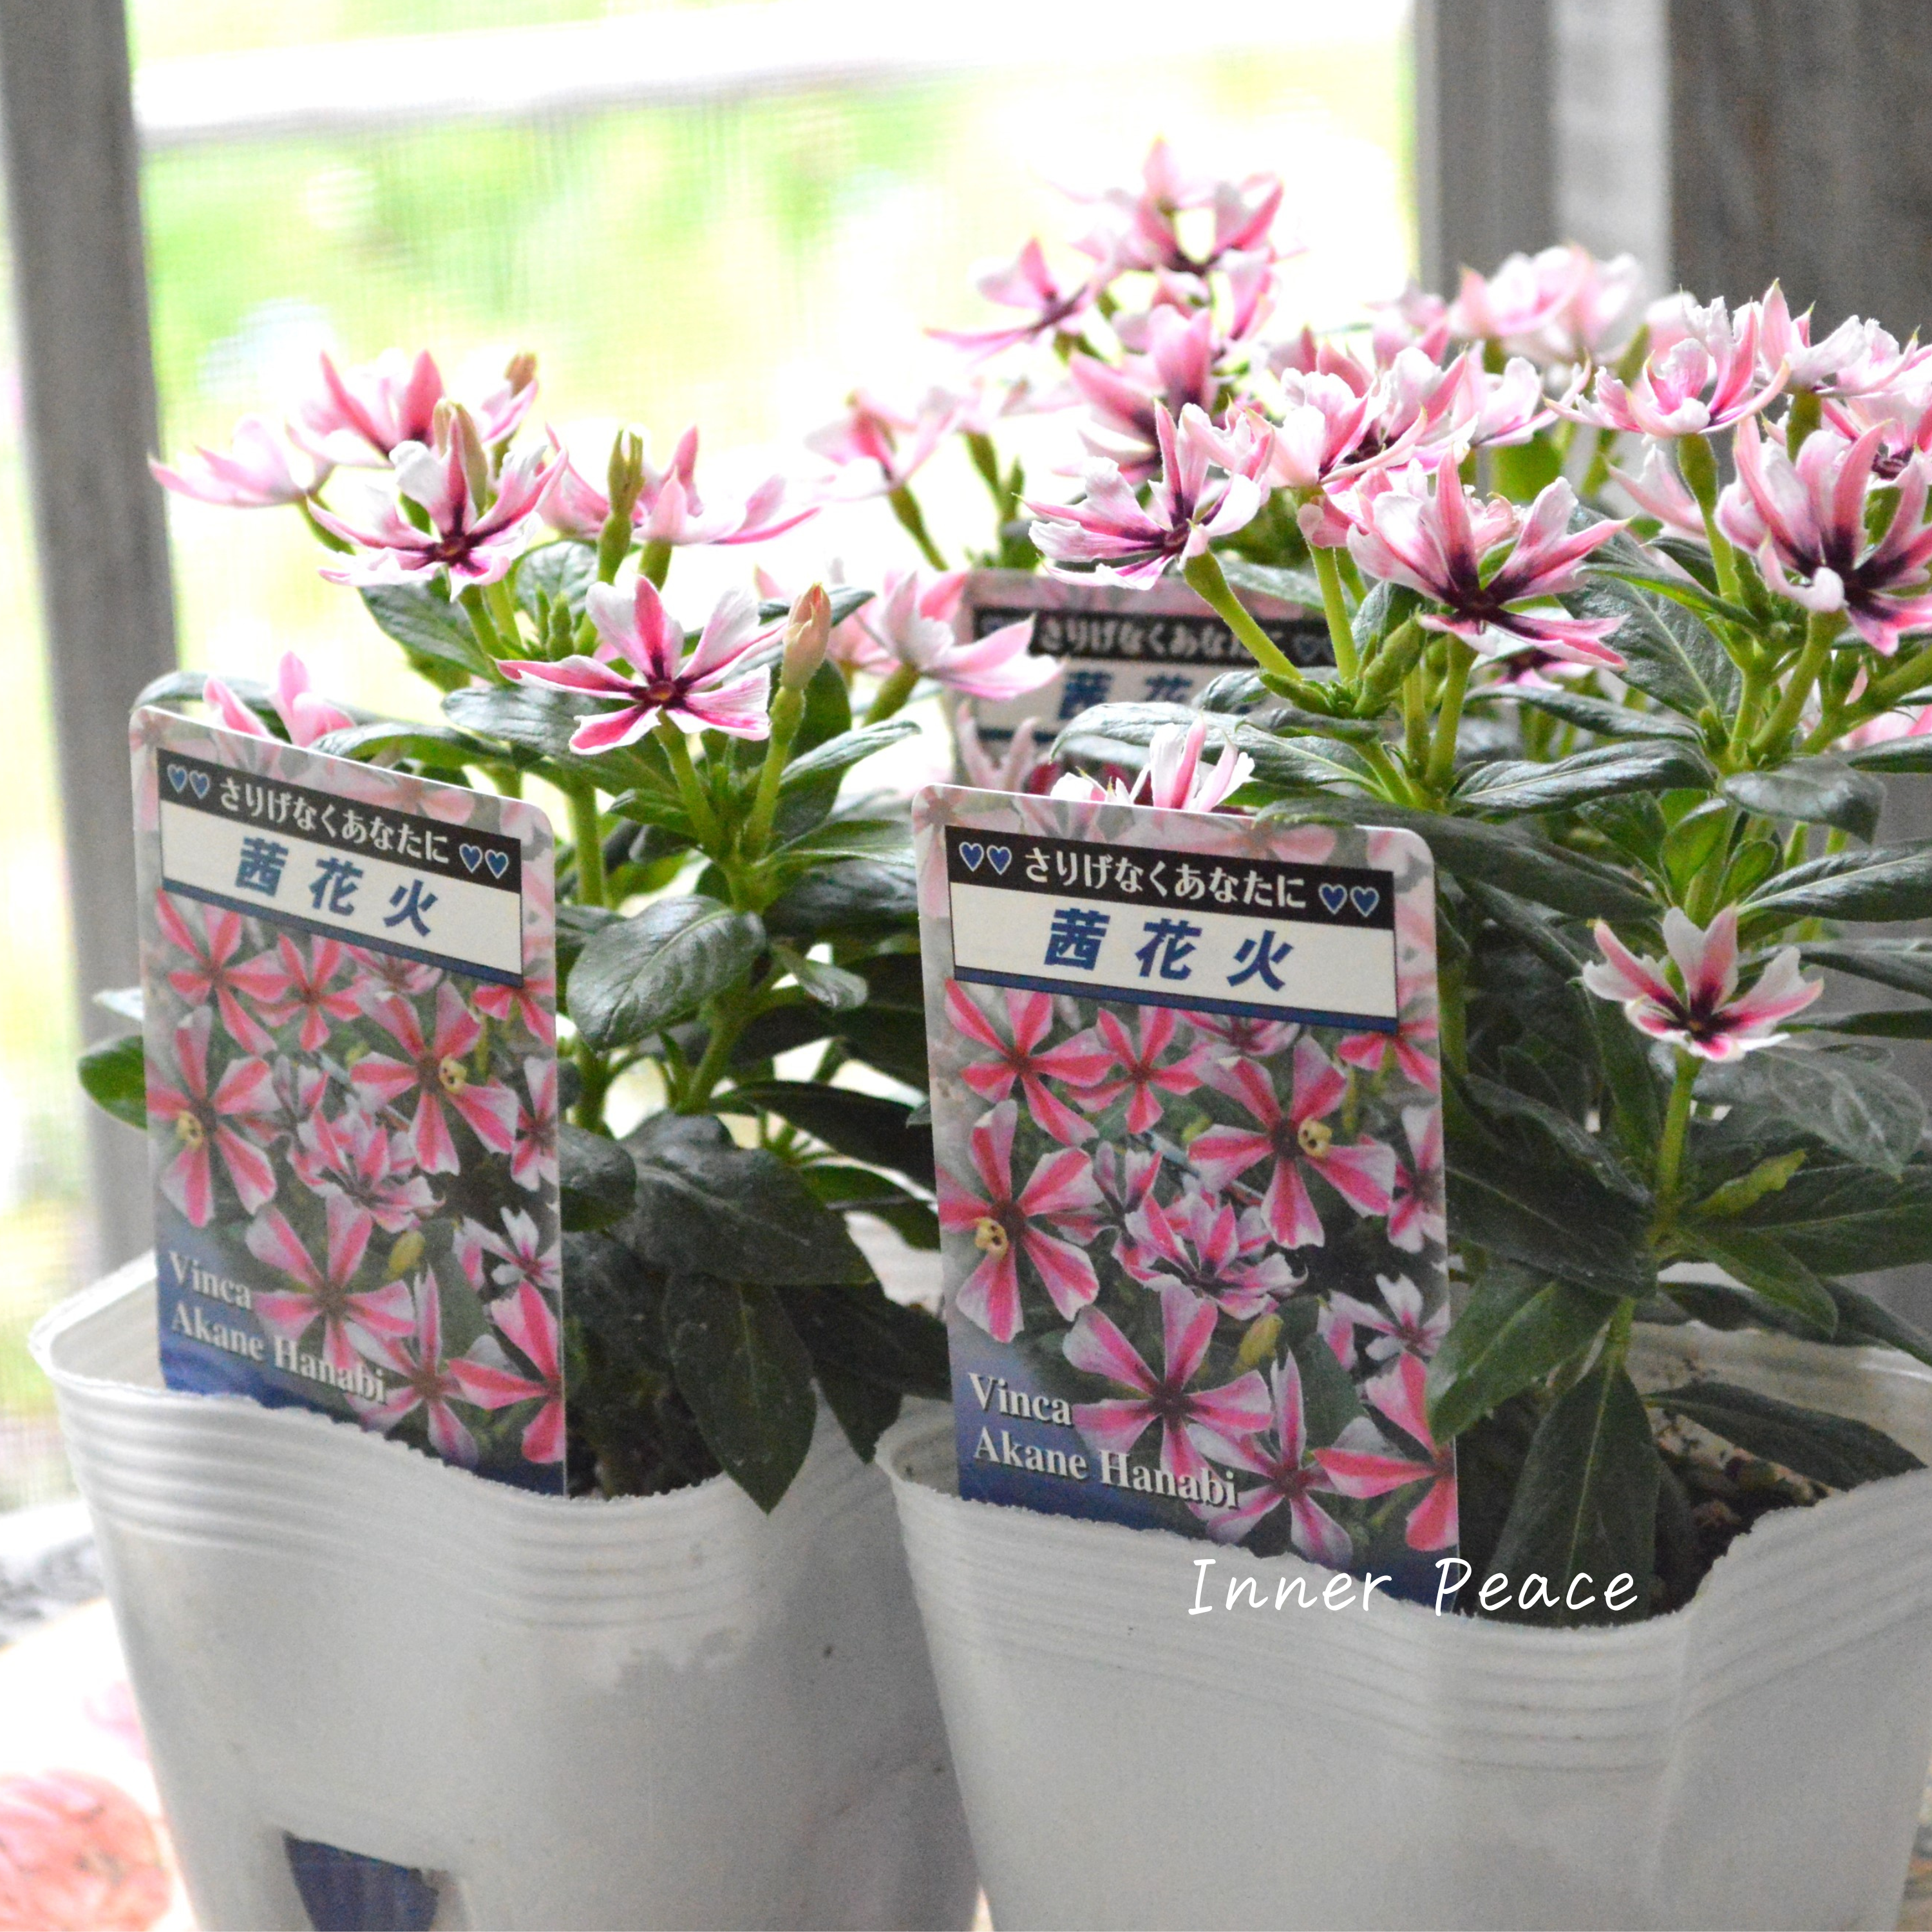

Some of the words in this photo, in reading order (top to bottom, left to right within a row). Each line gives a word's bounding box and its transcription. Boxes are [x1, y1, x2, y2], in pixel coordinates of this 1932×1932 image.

[1039, 614, 1283, 659] さりげなくあな
[220, 777, 450, 864] さりげなくあなたに
[235, 837, 438, 937] 茜花火
[1025, 847, 1307, 909] さりげなくあなたに
[1044, 907, 1294, 992] 茜花火
[168, 1250, 252, 1311] Vinca
[170, 1302, 265, 1360] Akane
[274, 1334, 387, 1405] Hanabi
[968, 1372, 1074, 1426] Vinca
[974, 1426, 1088, 1481] Akane
[1099, 1449, 1239, 1509] Hanabi
